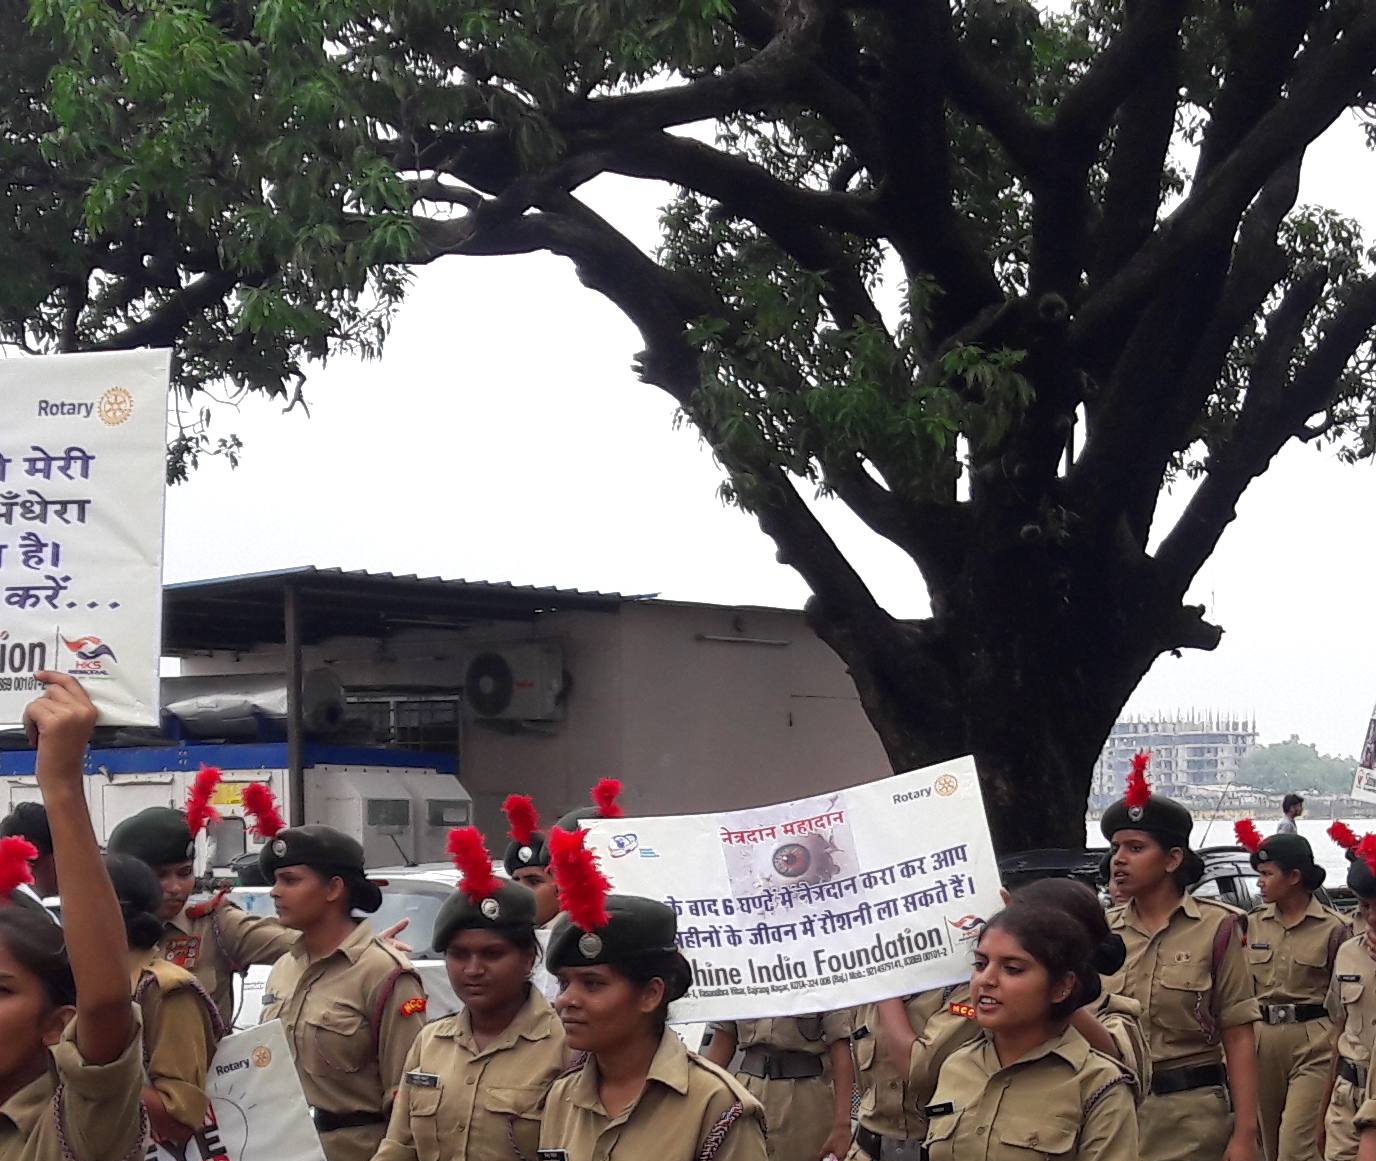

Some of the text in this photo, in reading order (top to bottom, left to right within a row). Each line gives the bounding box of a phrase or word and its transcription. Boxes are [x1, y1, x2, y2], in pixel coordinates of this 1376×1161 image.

[37, 399, 94, 418] Rotary
[23, 446, 96, 480] मेरी
[892, 787, 932, 805] Rotary
[720, 810, 845, 846] नेत्रदान महादान
[685, 898, 720, 917] बाद
[721, 898, 735, 916] 6
[798, 875, 857, 903] नेत्रदान
[859, 864, 896, 890] करा
[898, 856, 927, 879] कर
[930, 844, 969, 872] आप
[723, 924, 743, 948] के
[745, 922, 797, 946] जीवन
[799, 914, 818, 938] में
[818, 905, 873, 935] रौशनी
[874, 897, 900, 922] ला
[902, 881, 949, 913] सकते
[691, 927, 943, 987] hine India Foundation
[404, 1000, 422, 1014] NCC
[952, 1004, 975, 1017] NCC
[216, 1058, 250, 1076] Rotary
